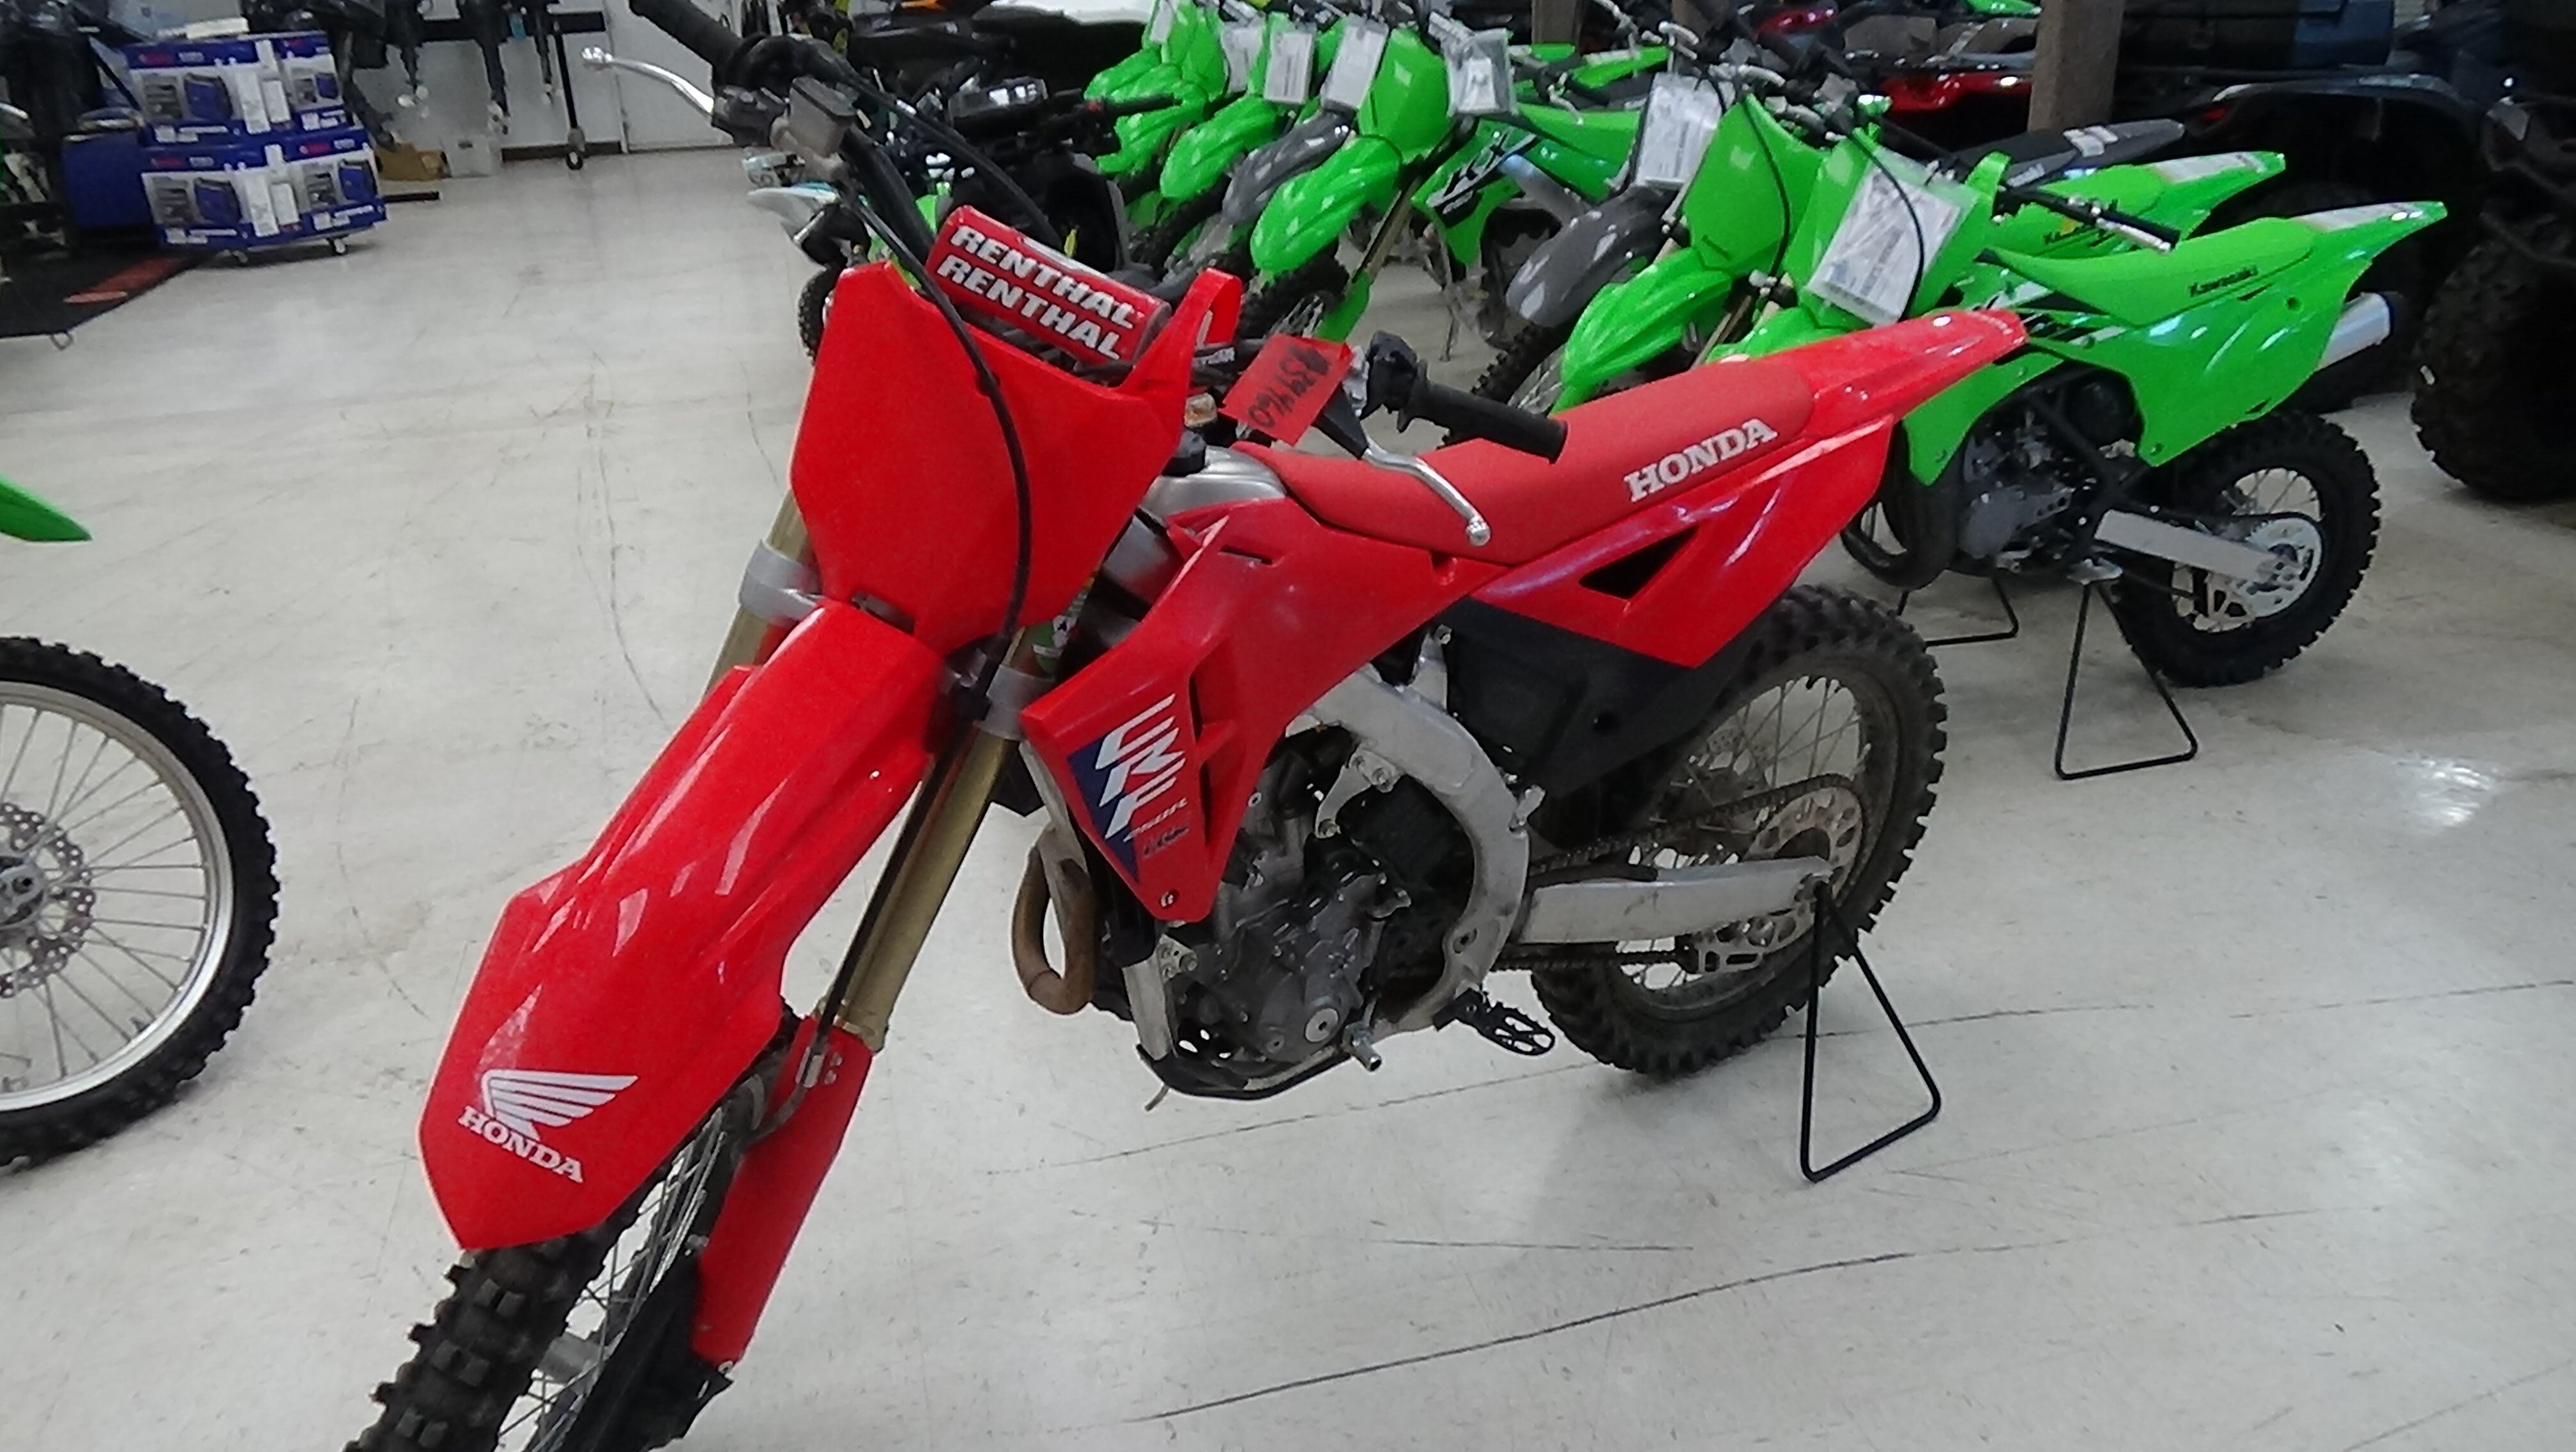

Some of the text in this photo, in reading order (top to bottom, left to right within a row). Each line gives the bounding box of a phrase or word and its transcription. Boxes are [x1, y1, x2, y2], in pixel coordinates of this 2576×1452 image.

[937, 254, 1121, 360] RENTHAL
[949, 224, 1135, 330] RENTHAL
[1623, 418, 1779, 502] HONDA
[457, 1105, 584, 1184] HONDA
